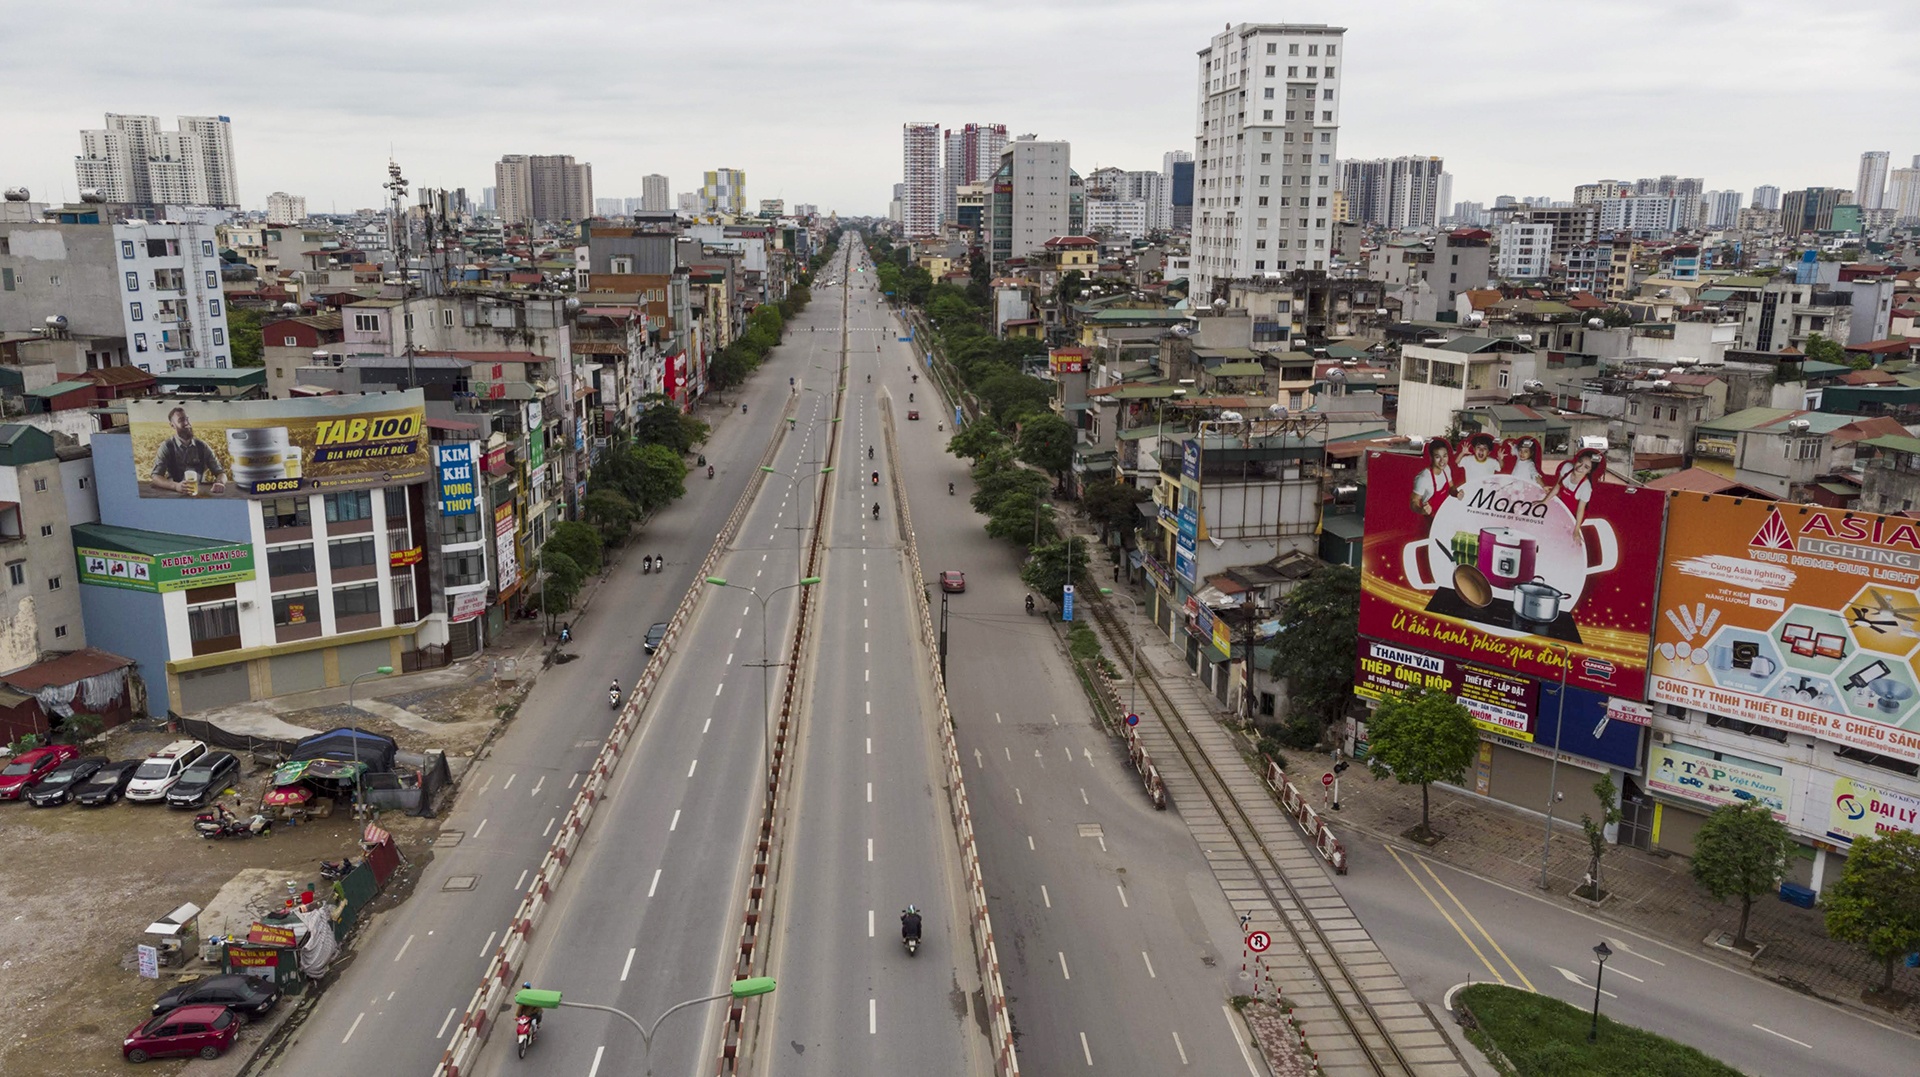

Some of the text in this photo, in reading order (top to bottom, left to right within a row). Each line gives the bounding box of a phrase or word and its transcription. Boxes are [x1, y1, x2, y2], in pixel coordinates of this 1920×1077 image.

[315, 417, 412, 445] TAB 100
[327, 451, 343, 460] BIA
[441, 448, 469, 462] KIM
[443, 463, 470, 480] KHÍ
[256, 480, 299, 492] 1800 6265
[443, 482, 472, 497] VỌNG
[1467, 487, 1548, 519] Mama
[1799, 512, 1920, 549] ASIA
[162, 558, 173, 568] XE
[200, 553, 211, 563] XE
[1807, 540, 1911, 566] LIGHTING
[1710, 561, 1786, 581] Cùng Asia lighting
[1748, 549, 1919, 585] YOUR HOME-OUR LIGHT
[1756, 597, 1778, 608] 80%
[1391, 609, 1406, 629] Ủ
[1407, 614, 1430, 637] ấm
[1431, 623, 1470, 646] hạnh
[1469, 631, 1506, 655] phúc
[1509, 643, 1534, 667] gia
[1375, 646, 1439, 671] THANH VÂN
[1360, 657, 1392, 676] THÉP
[1394, 664, 1422, 685] ỐNG
[1465, 674, 1483, 686] THIẾT
[1657, 680, 1885, 741] CÔNG TY TNHH THIẾT BỊ ĐIỆN & CHIẾU
[1498, 716, 1524, 730] FOMEX
[1681, 760, 1727, 781] TAP
[1728, 774, 1749, 787] Việt
[1750, 780, 1777, 793] Nam
[1869, 799, 1896, 818] ĐẠI
